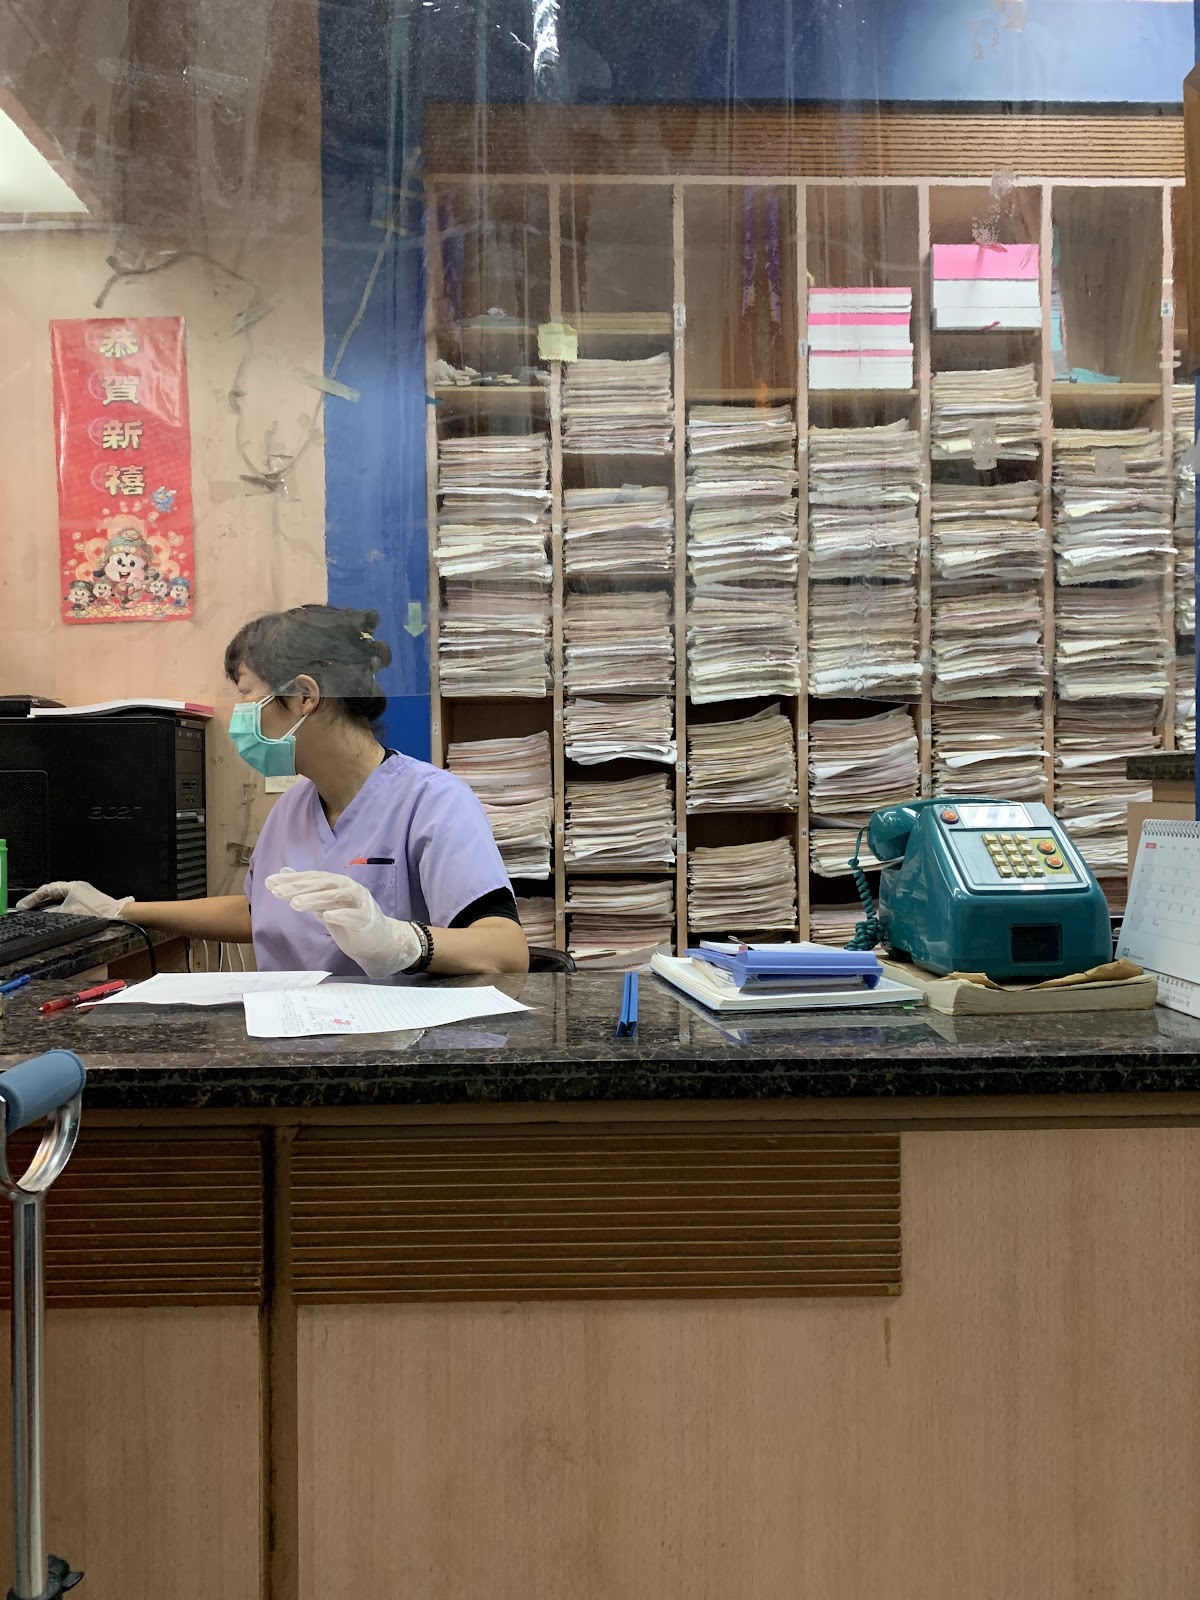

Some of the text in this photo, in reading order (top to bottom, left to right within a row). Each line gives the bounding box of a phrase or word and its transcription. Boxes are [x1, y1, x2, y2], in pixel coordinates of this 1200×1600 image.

[99, 327, 146, 496] 恭賀新禧
[87, 805, 142, 820] acer
[1122, 947, 1131, 958] 02
